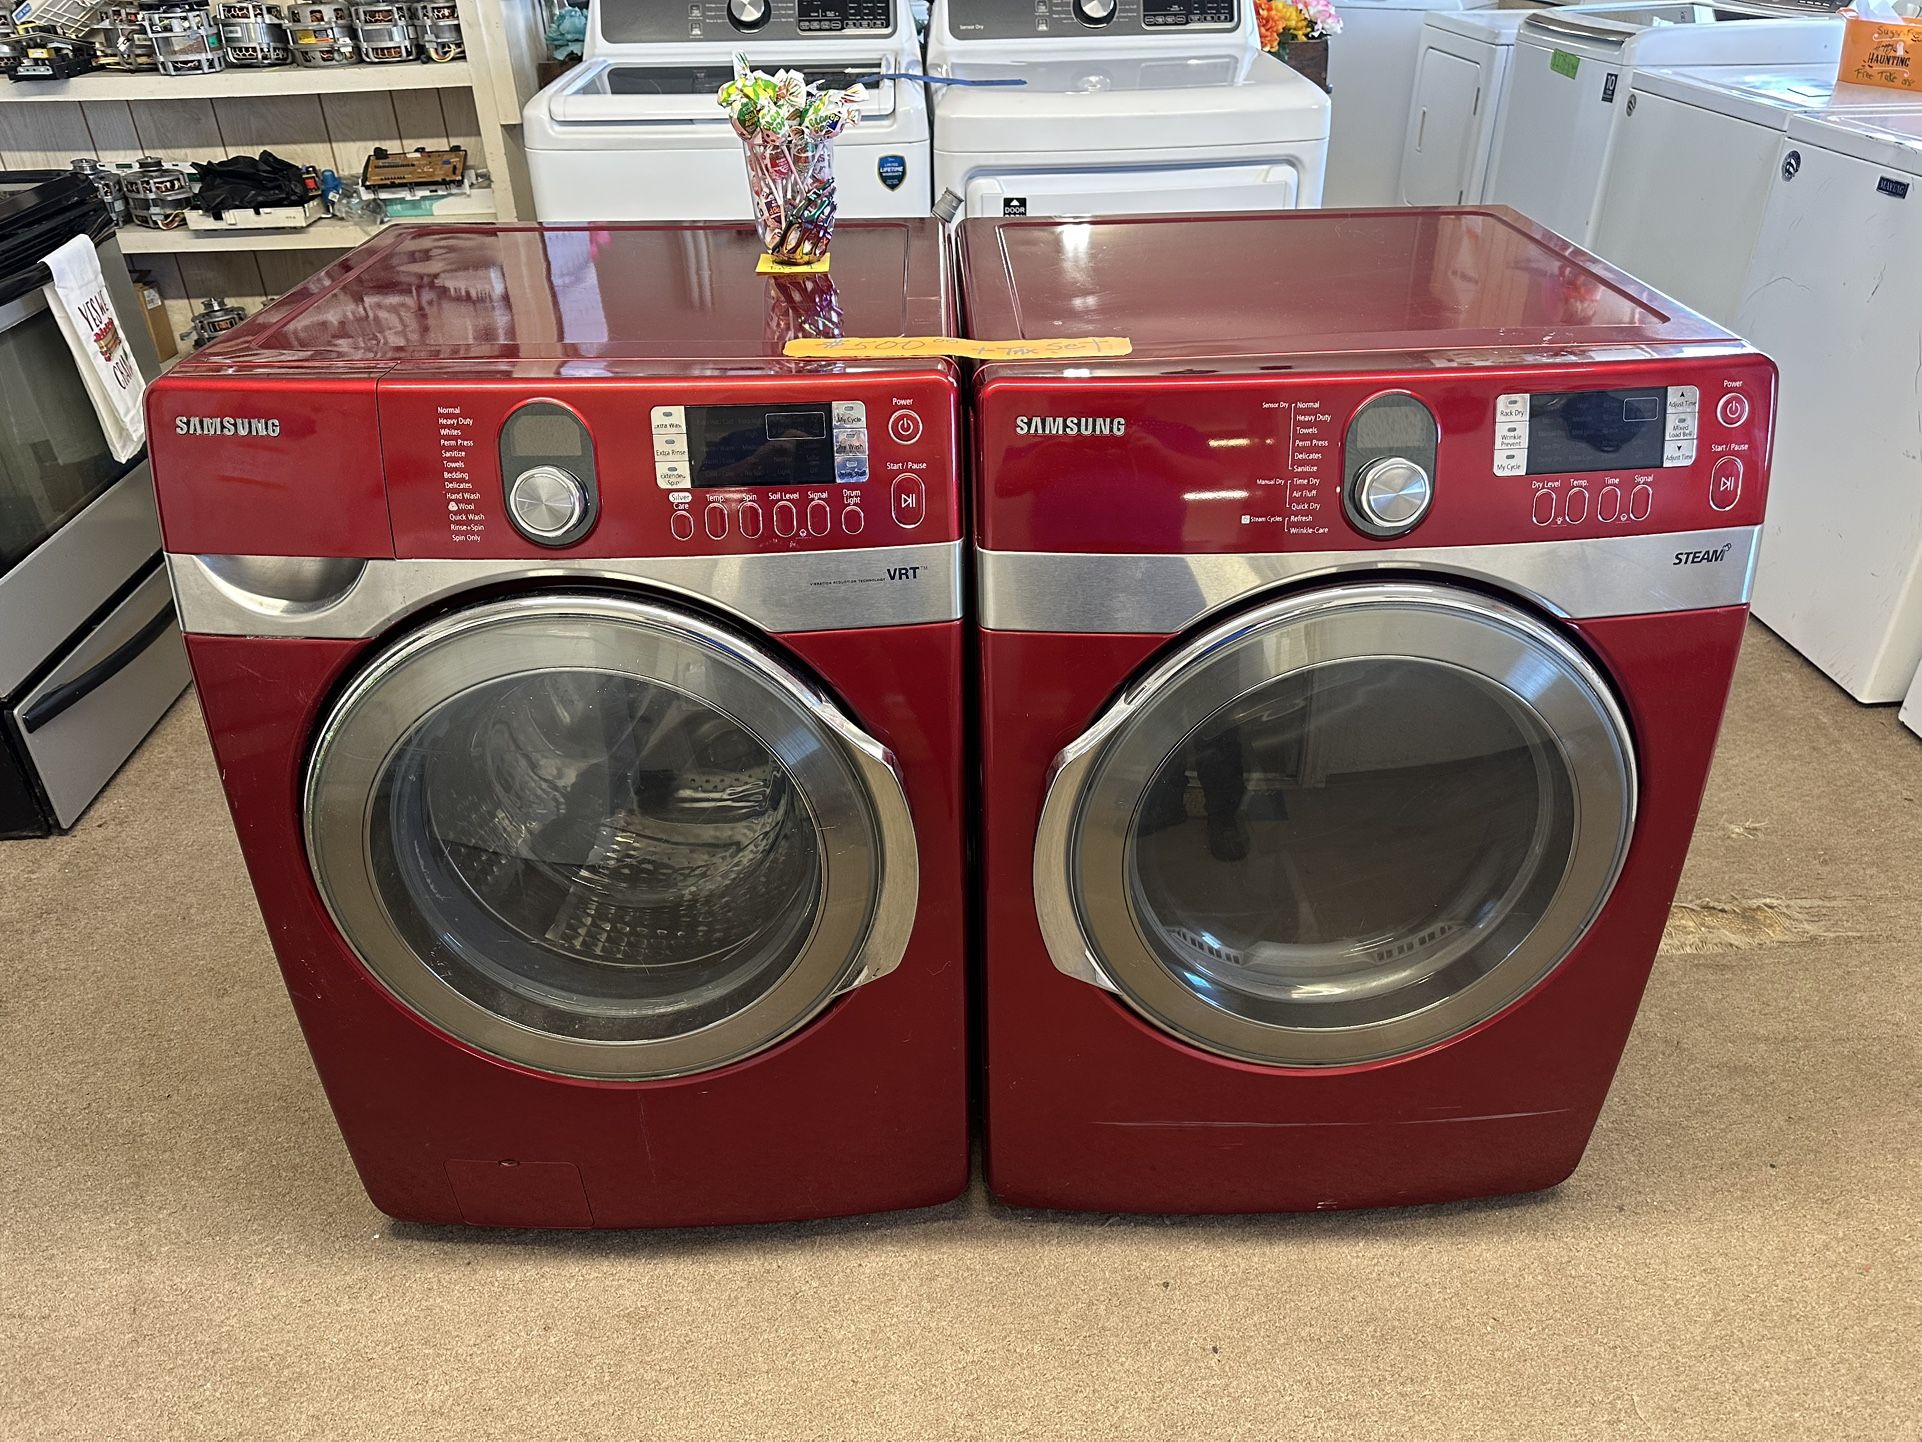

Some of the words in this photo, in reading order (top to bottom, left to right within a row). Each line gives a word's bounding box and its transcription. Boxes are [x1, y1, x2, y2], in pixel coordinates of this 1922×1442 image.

[1868, 52, 1911, 68] HAUNTING
[1855, 68, 1873, 80] Free
[1877, 71, 1897, 83] Take
[1878, 179, 1905, 194] MAYTAG
[1005, 206, 1025, 214] DOOR
[78, 298, 103, 332] YES
[1723, 380, 1743, 388] Power
[892, 398, 913, 406] Power
[1279, 401, 1289, 410] Dry
[437, 406, 461, 414] Normal
[1514, 409, 1524, 418] Dry
[438, 417, 458, 426] Heavy
[458, 417, 474, 426] Duty
[1296, 414, 1315, 422] Heavy
[1316, 414, 1332, 423] Duty
[175, 416, 280, 437] SAMSUNG
[1016, 416, 1125, 436] SAMSUNG
[1296, 426, 1318, 434] Towels
[439, 428, 462, 436] Whites
[440, 439, 457, 447] Perm
[457, 439, 474, 447] Press
[1295, 439, 1311, 447] Perm
[1312, 439, 1329, 447] Press
[1711, 444, 1726, 452] Start
[1730, 443, 1749, 451] Pause
[441, 449, 466, 458] Sanitize
[671, 449, 686, 457] Rinse
[1294, 452, 1322, 460] Delicates
[1665, 454, 1681, 462] Adjust
[443, 460, 465, 468] Towels
[886, 462, 903, 470] Start
[1506, 463, 1521, 471] Cycle
[443, 472, 469, 480] Bedding
[1634, 474, 1654, 484] Signal
[1274, 479, 1285, 487] Dry
[1309, 478, 1320, 487] Dry
[1532, 480, 1543, 490] Dry
[1544, 480, 1561, 488] Level
[1570, 479, 1589, 488] Temp.
[446, 492, 463, 500] Hand
[463, 492, 481, 500] Wash
[768, 492, 782, 500] Soil
[807, 491, 828, 499] Signal
[842, 489, 861, 497] Drum
[706, 494, 726, 502] Temp.
[742, 493, 757, 502] Spin
[844, 496, 861, 505] Light
[673, 502, 689, 510] Care
[1291, 502, 1309, 510] Quick
[1309, 502, 1321, 511] Dry
[449, 513, 467, 521] Quick
[1267, 515, 1283, 523] Cycles
[450, 524, 485, 532] Rinse+Spin
[452, 534, 466, 543] Spin
[466, 534, 481, 543] Only
[1673, 549, 1726, 566] STEAM
[886, 566, 920, 581] VRT
